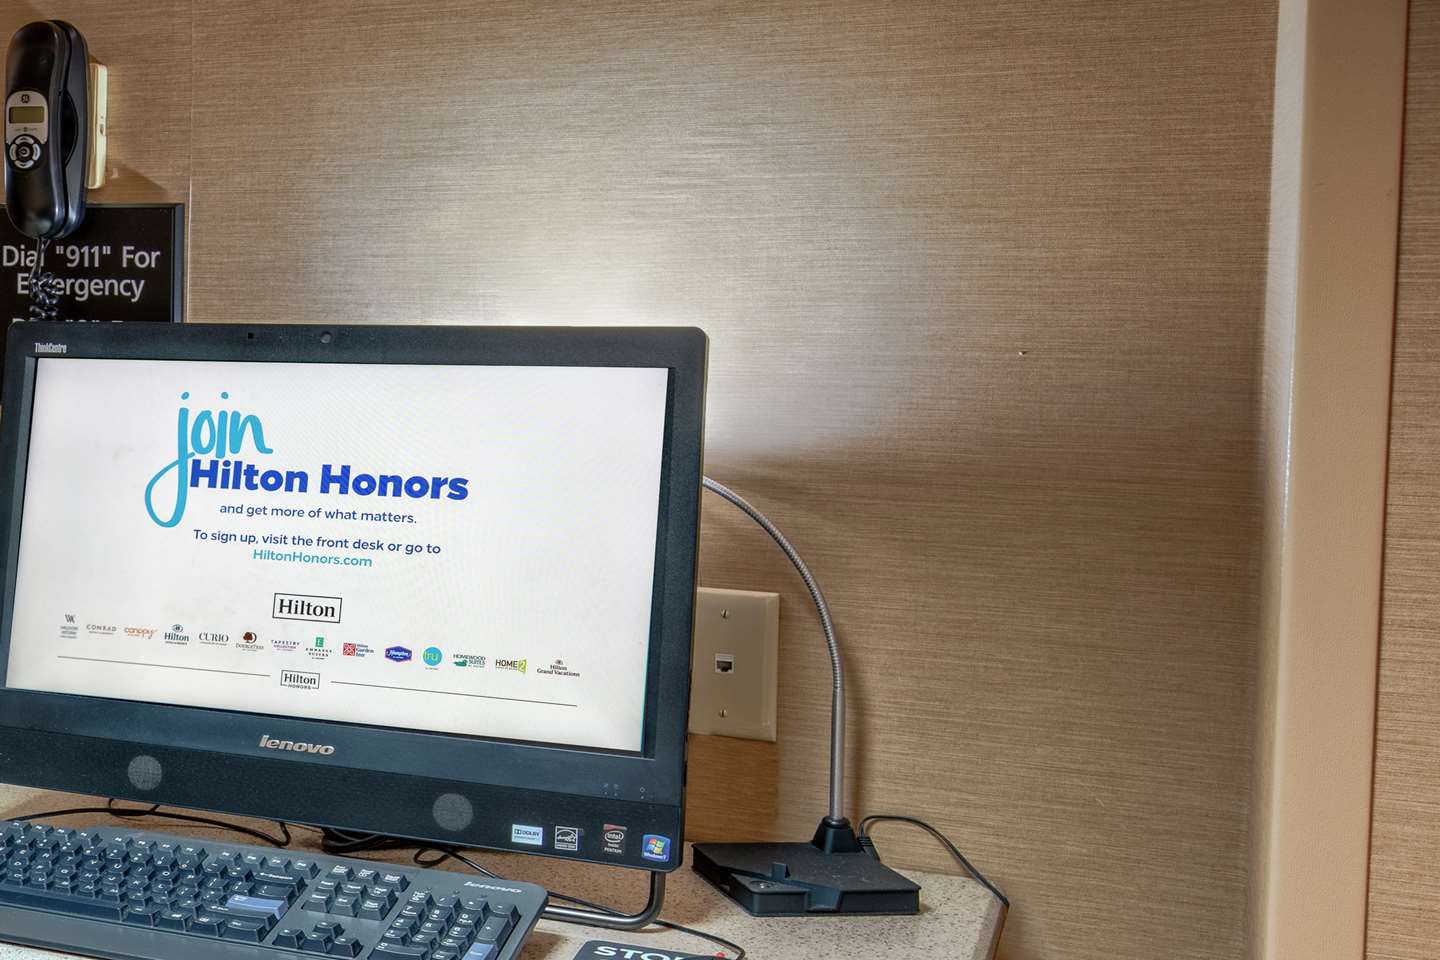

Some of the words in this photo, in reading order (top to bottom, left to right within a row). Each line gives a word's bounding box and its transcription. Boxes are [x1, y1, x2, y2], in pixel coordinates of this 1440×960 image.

[2, 245, 45, 267] Dial
[55, 245, 112, 268] "911"
[121, 245, 161, 269] For
[17, 273, 146, 303] Eergency
[144, 391, 274, 528] join
[190, 458, 309, 493] Hilton
[319, 464, 469, 501] Honors
[220, 504, 244, 514] and
[246, 505, 268, 517] get
[271, 508, 305, 518] more
[308, 507, 322, 518] of
[325, 509, 357, 520] what
[361, 511, 417, 524] matters.
[193, 529, 208, 540] To
[211, 530, 237, 544] sign
[240, 534, 259, 545] up,
[262, 534, 288, 545] visit
[292, 535, 313, 546] the
[316, 537, 349, 549] front
[353, 539, 384, 551] desk
[388, 543, 402, 552] or
[405, 544, 423, 555] go
[426, 544, 441, 554] to
[253, 549, 373, 567] HiltonHonors.com
[278, 598, 336, 618] Hilton
[86, 624, 117, 632] CONRAD
[164, 632, 189, 642] Hilton
[198, 632, 230, 642] CURIO
[284, 673, 316, 685] Hilton
[259, 734, 335, 756] lenovo
[464, 881, 522, 894] lenovo
